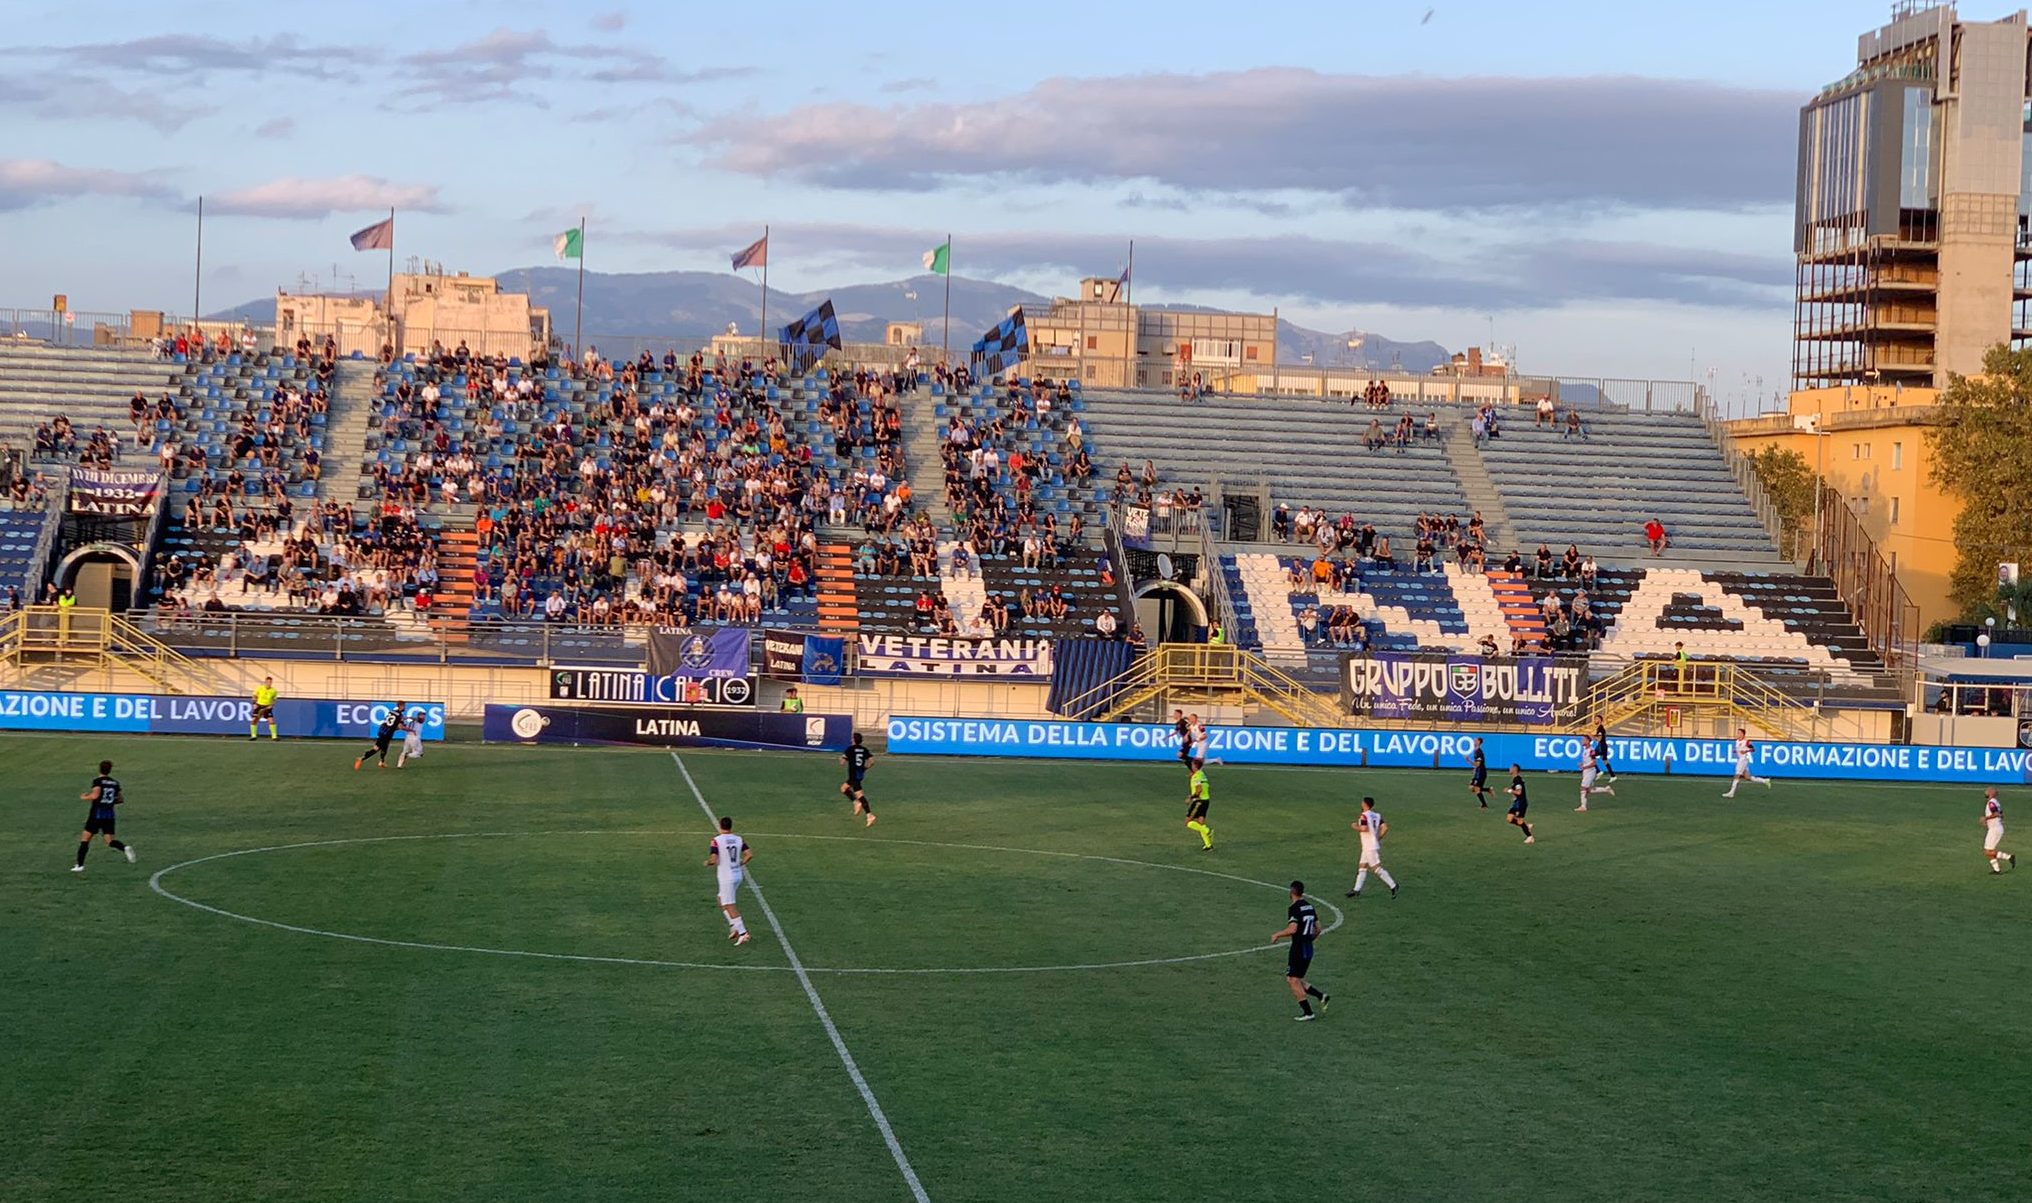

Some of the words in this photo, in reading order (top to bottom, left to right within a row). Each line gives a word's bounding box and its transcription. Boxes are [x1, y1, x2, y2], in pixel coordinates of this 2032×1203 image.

[94, 487, 135, 499] 1932
[72, 499, 155, 515] LATINA
[659, 626, 692, 635] LATINA
[859, 634, 1034, 660] VETERANI
[770, 658, 796, 671] LATINA
[860, 659, 1034, 674] LATINA
[709, 669, 736, 678] CREW
[1350, 658, 1448, 699] GRUPPO
[1482, 665, 1579, 704] BOLLITI
[576, 671, 646, 701] LATINA
[727, 686, 747, 695] 1932
[93, 697, 107, 718] E
[115, 698, 163, 720] DEL
[170, 700, 268, 722] LAVOR
[636, 718, 701, 737] LATINA
[887, 720, 1020, 744] OSISTEMA
[1028, 724, 1108, 746] DELLA
[1297, 731, 1310, 751] E
[1319, 733, 1363, 754] DEL
[1374, 735, 1476, 756] LAVORO
[855, 753, 863, 767] 5
[1761, 745, 1910, 768] FORMAZIONE
[1918, 749, 1929, 769] E
[1937, 750, 1978, 770] DEL
[726, 845, 738, 863] 10
